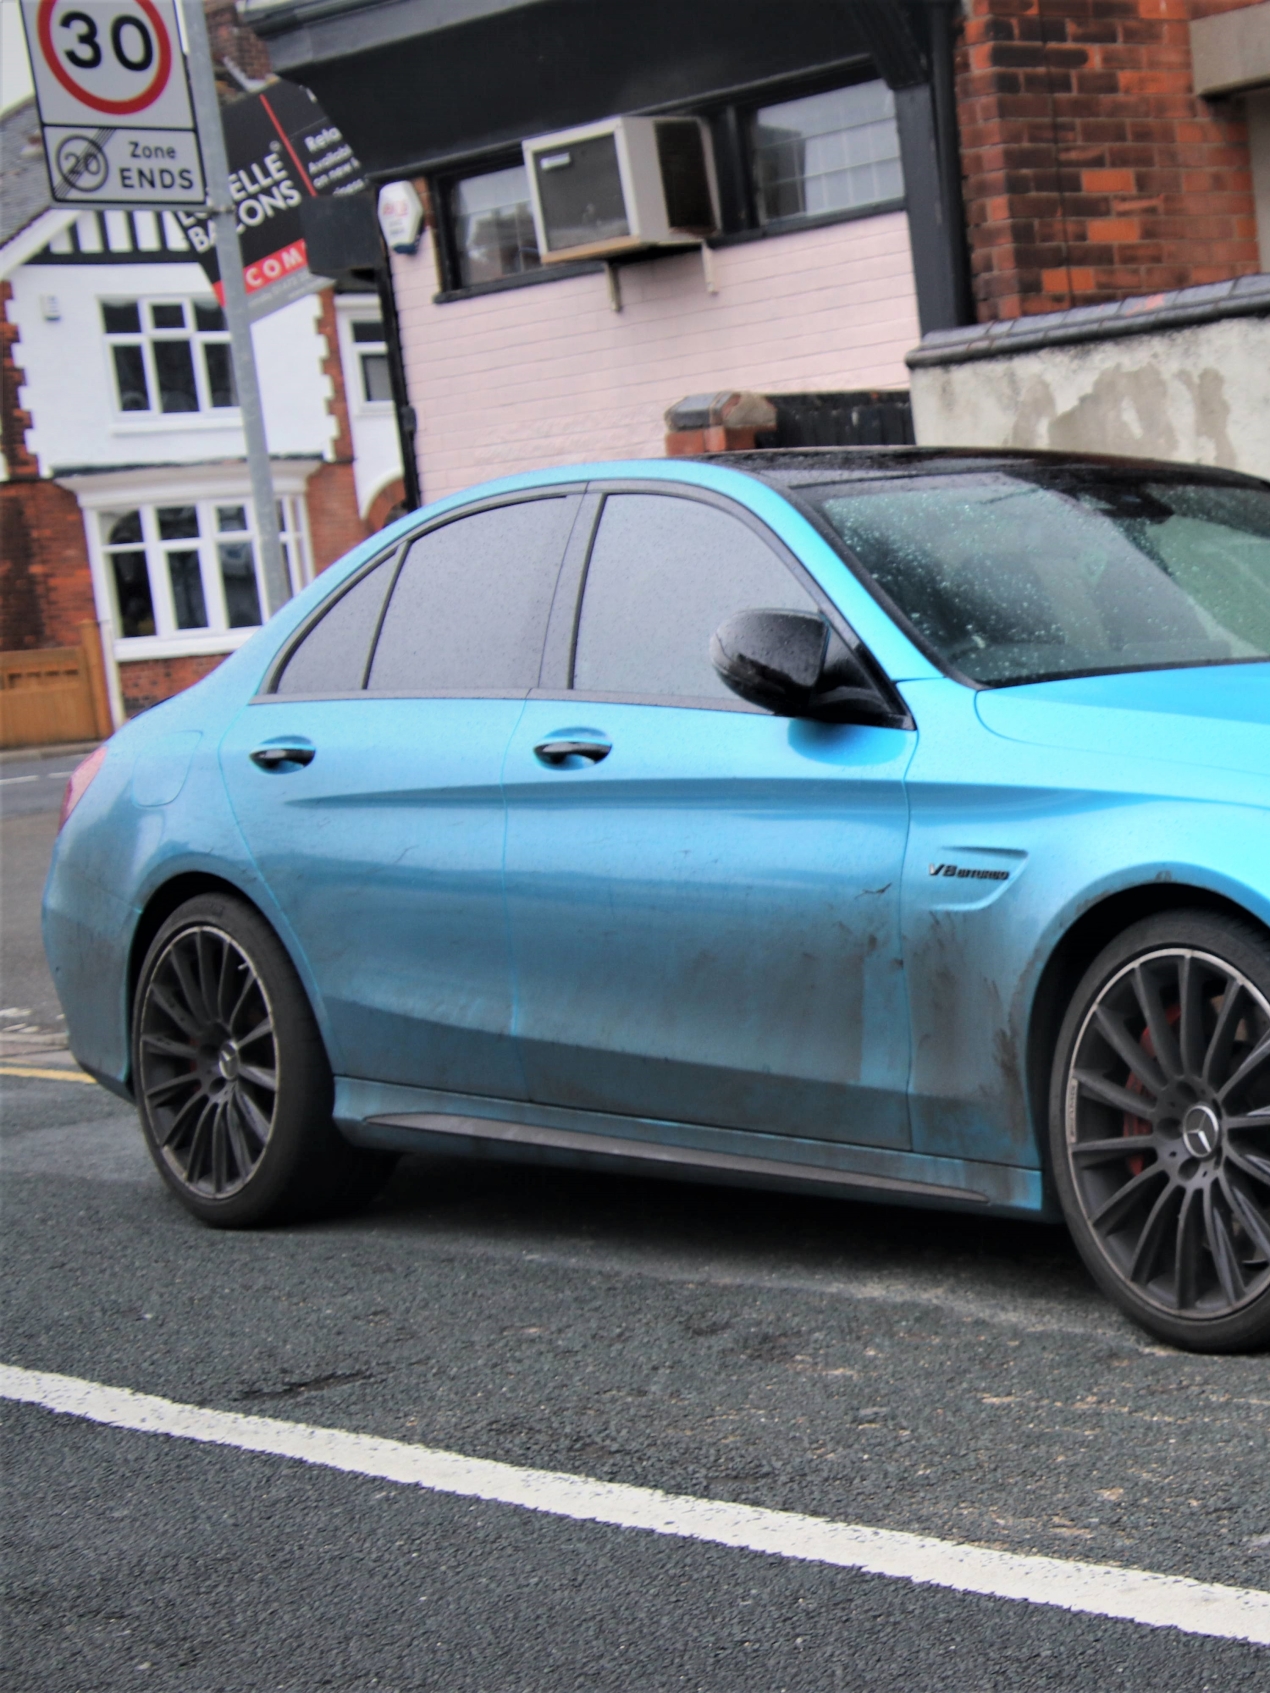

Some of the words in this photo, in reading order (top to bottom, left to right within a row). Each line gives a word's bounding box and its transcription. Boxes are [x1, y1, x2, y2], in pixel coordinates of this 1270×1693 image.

[59, 11, 153, 71] 30
[129, 141, 177, 159] Zone
[119, 167, 193, 190] ENDS
[177, 152, 288, 227] LELLE
